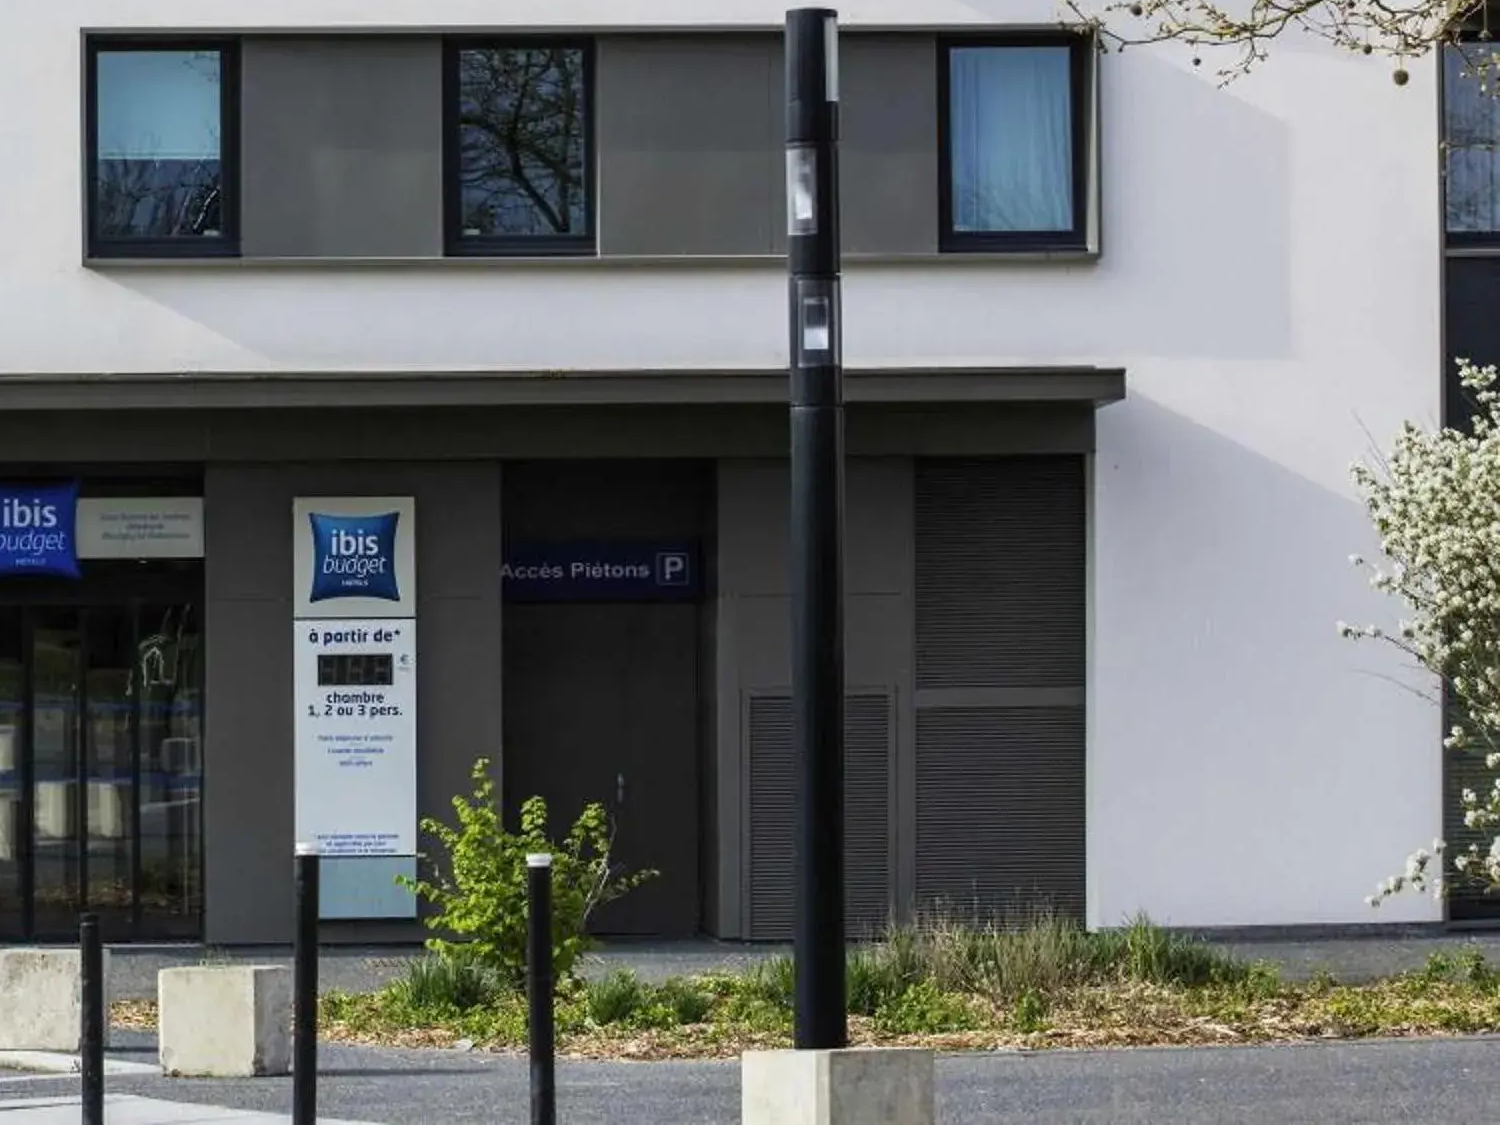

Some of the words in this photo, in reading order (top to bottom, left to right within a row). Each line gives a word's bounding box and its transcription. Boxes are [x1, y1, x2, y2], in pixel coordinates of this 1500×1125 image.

[2, 498, 57, 528] ibis
[331, 528, 379, 555] ibis
[323, 555, 387, 578] budget
[499, 562, 564, 580] Accès
[571, 560, 650, 580] Piétons
[323, 629, 368, 646] partir
[326, 692, 385, 704] chambre
[324, 704, 333, 716] 2
[337, 706, 353, 716] ou
[358, 704, 366, 716] 3
[370, 705, 403, 719] pers.
